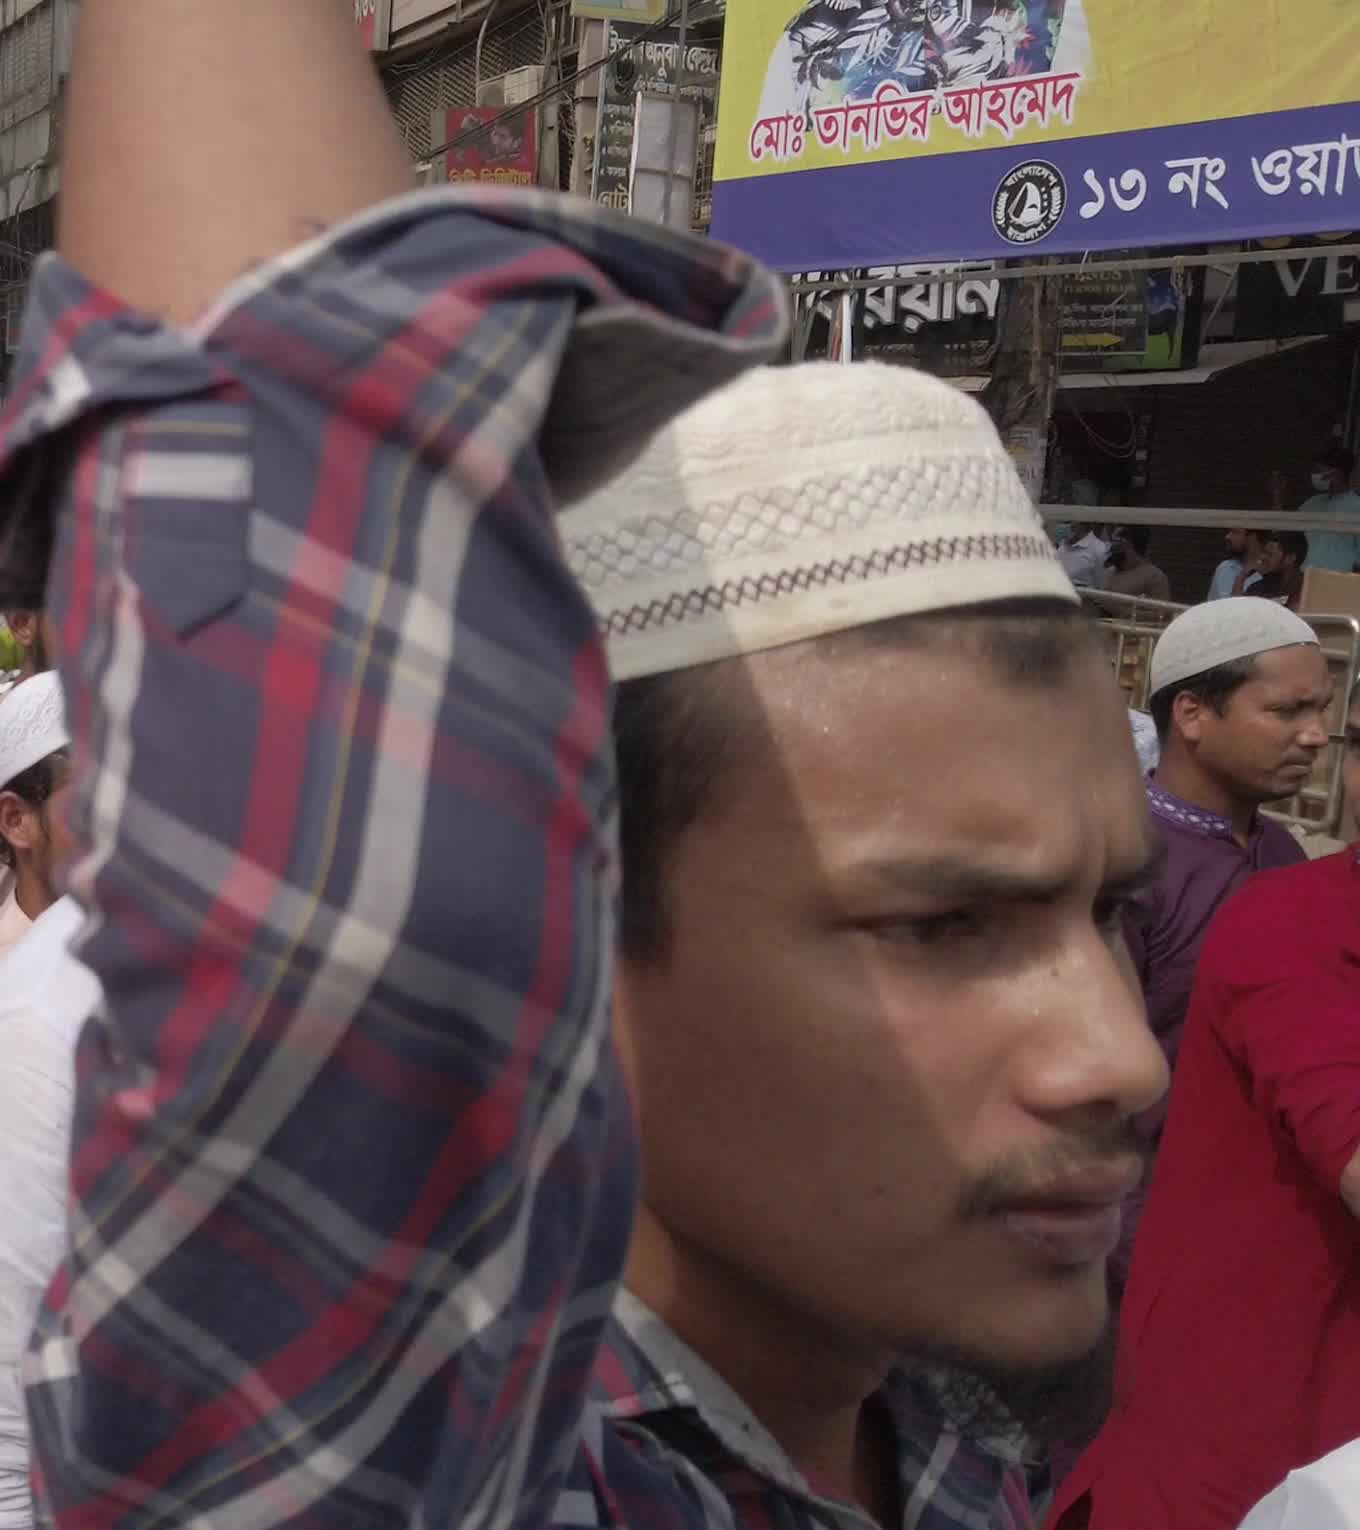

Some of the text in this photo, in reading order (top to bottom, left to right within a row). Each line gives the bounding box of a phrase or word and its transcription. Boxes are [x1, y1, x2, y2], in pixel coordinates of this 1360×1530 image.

[645, 42, 686, 80] অনুবা
[750, 72, 1081, 159] মোঃ তানভির আহমেদ
[1078, 132, 1360, 220] ১৩ নং ওয়া
